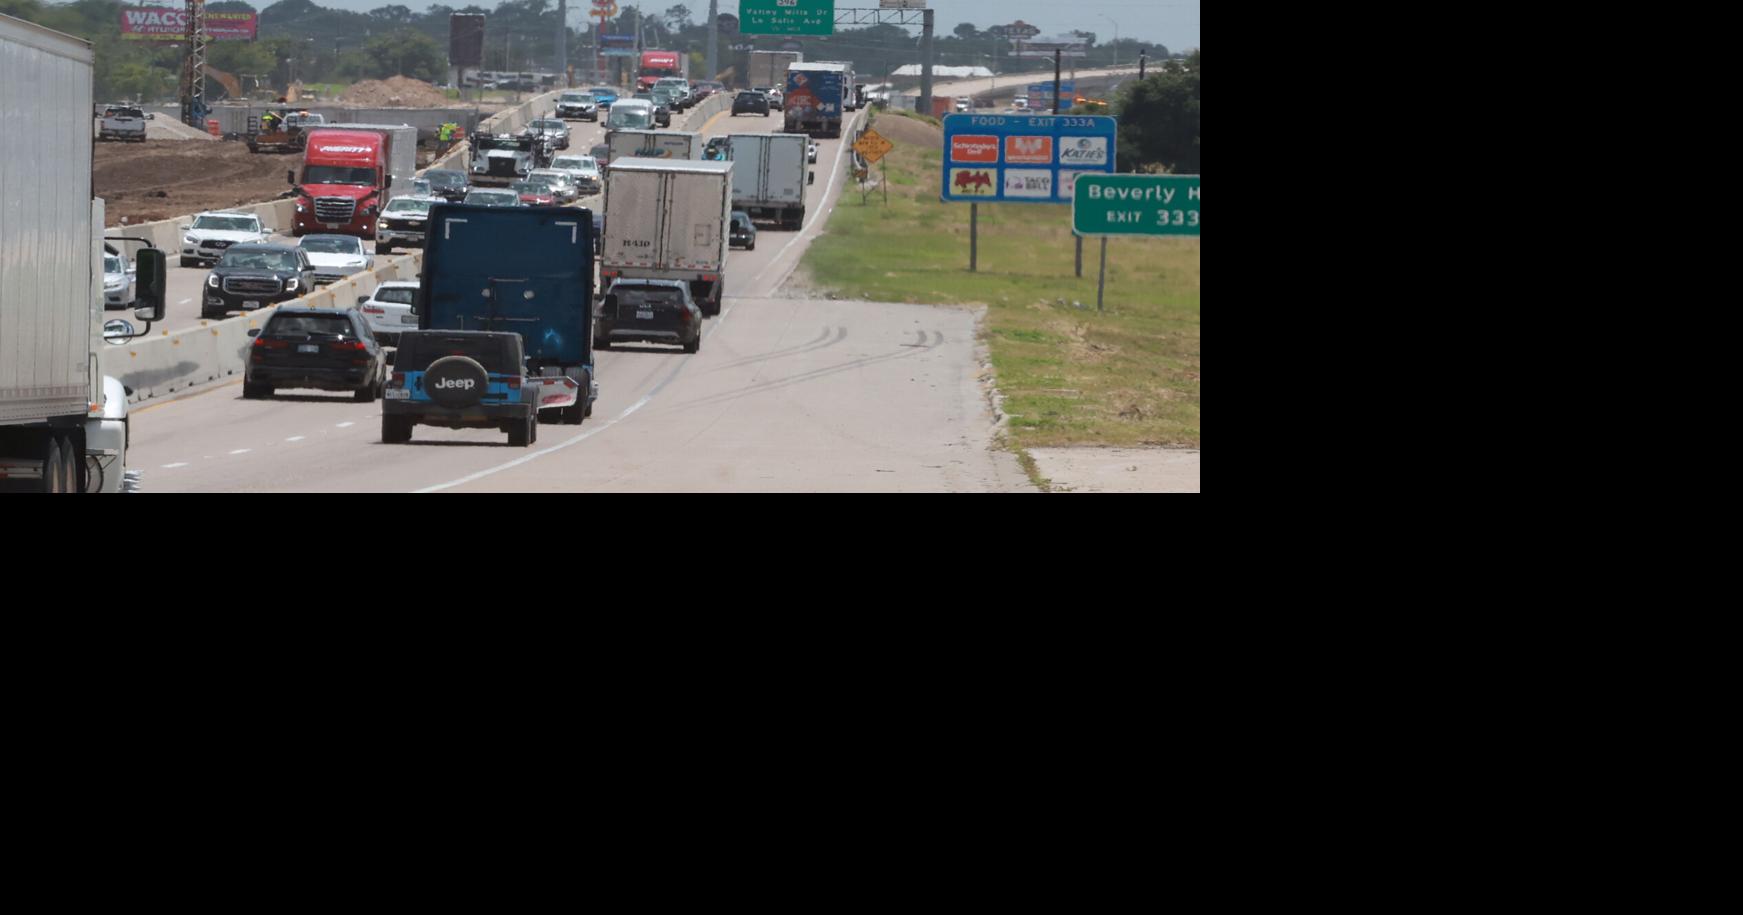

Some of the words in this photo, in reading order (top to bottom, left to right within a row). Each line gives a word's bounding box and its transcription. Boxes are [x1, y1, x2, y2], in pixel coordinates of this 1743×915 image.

[971, 116, 1006, 126] FOOD
[1028, 117, 1057, 127] EXIT
[1063, 118, 1096, 127] 333A
[1088, 184, 1175, 204] Beverly
[1106, 210, 1142, 223] EXIT
[1156, 209, 1200, 226] 333
[435, 377, 475, 390] Jeep
